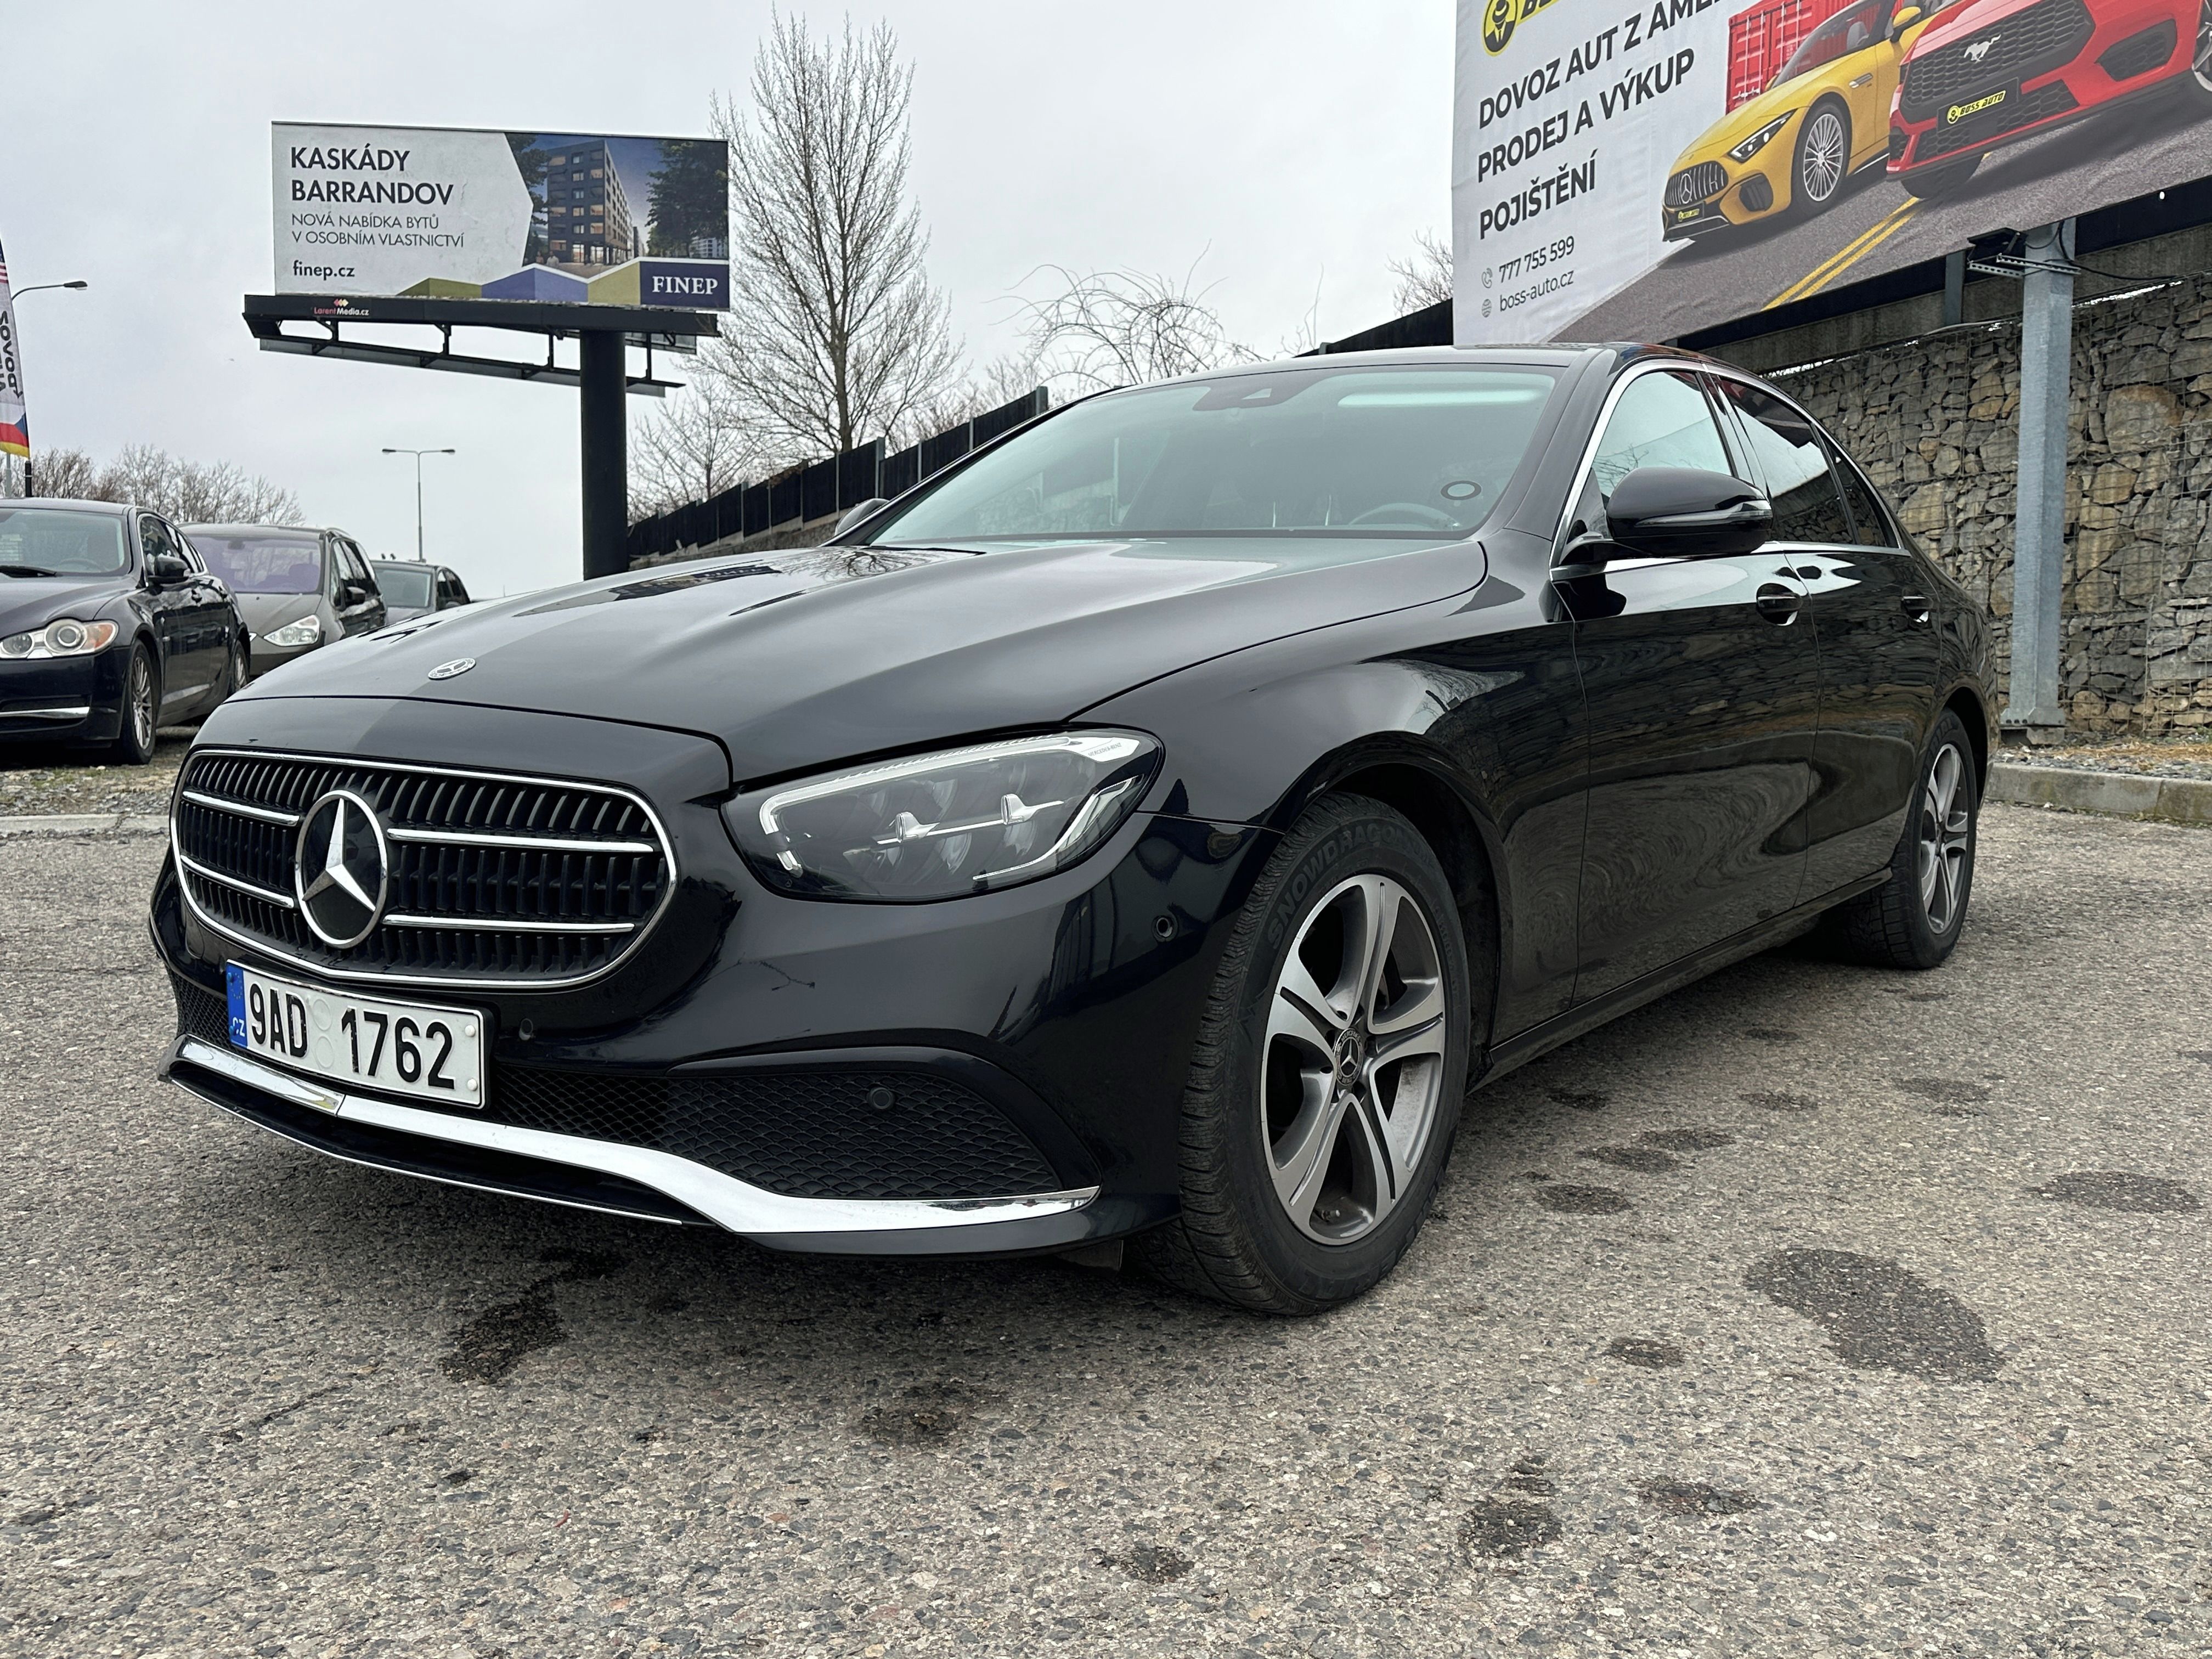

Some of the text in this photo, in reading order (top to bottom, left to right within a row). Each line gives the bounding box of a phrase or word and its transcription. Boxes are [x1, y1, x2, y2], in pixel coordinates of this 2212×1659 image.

[1480, 0, 1720, 129] DOVOZ AUT Z AM
[1479, 48, 1694, 183] PRODEJ A VÝKUP
[1960, 92, 2004, 115] BOSS AUTO
[291, 143, 410, 171] KASKÁDY
[292, 180, 454, 205] BARRANDOV
[1480, 148, 1598, 240] POJIŠTĚNÍ
[292, 211, 439, 229] NOVÁ NABÍDKA BYTŮ
[292, 230, 464, 247] V OSOBNÍM VLASTNICTVÍ
[293, 260, 355, 281] finep.cz
[1499, 235, 1575, 283] 777 755 599
[652, 276, 718, 294] FINEP
[1500, 270, 1575, 312] boss-auto.cz
[232, 1017, 245, 1037] CZ
[250, 983, 455, 1090] 9AD 1762
